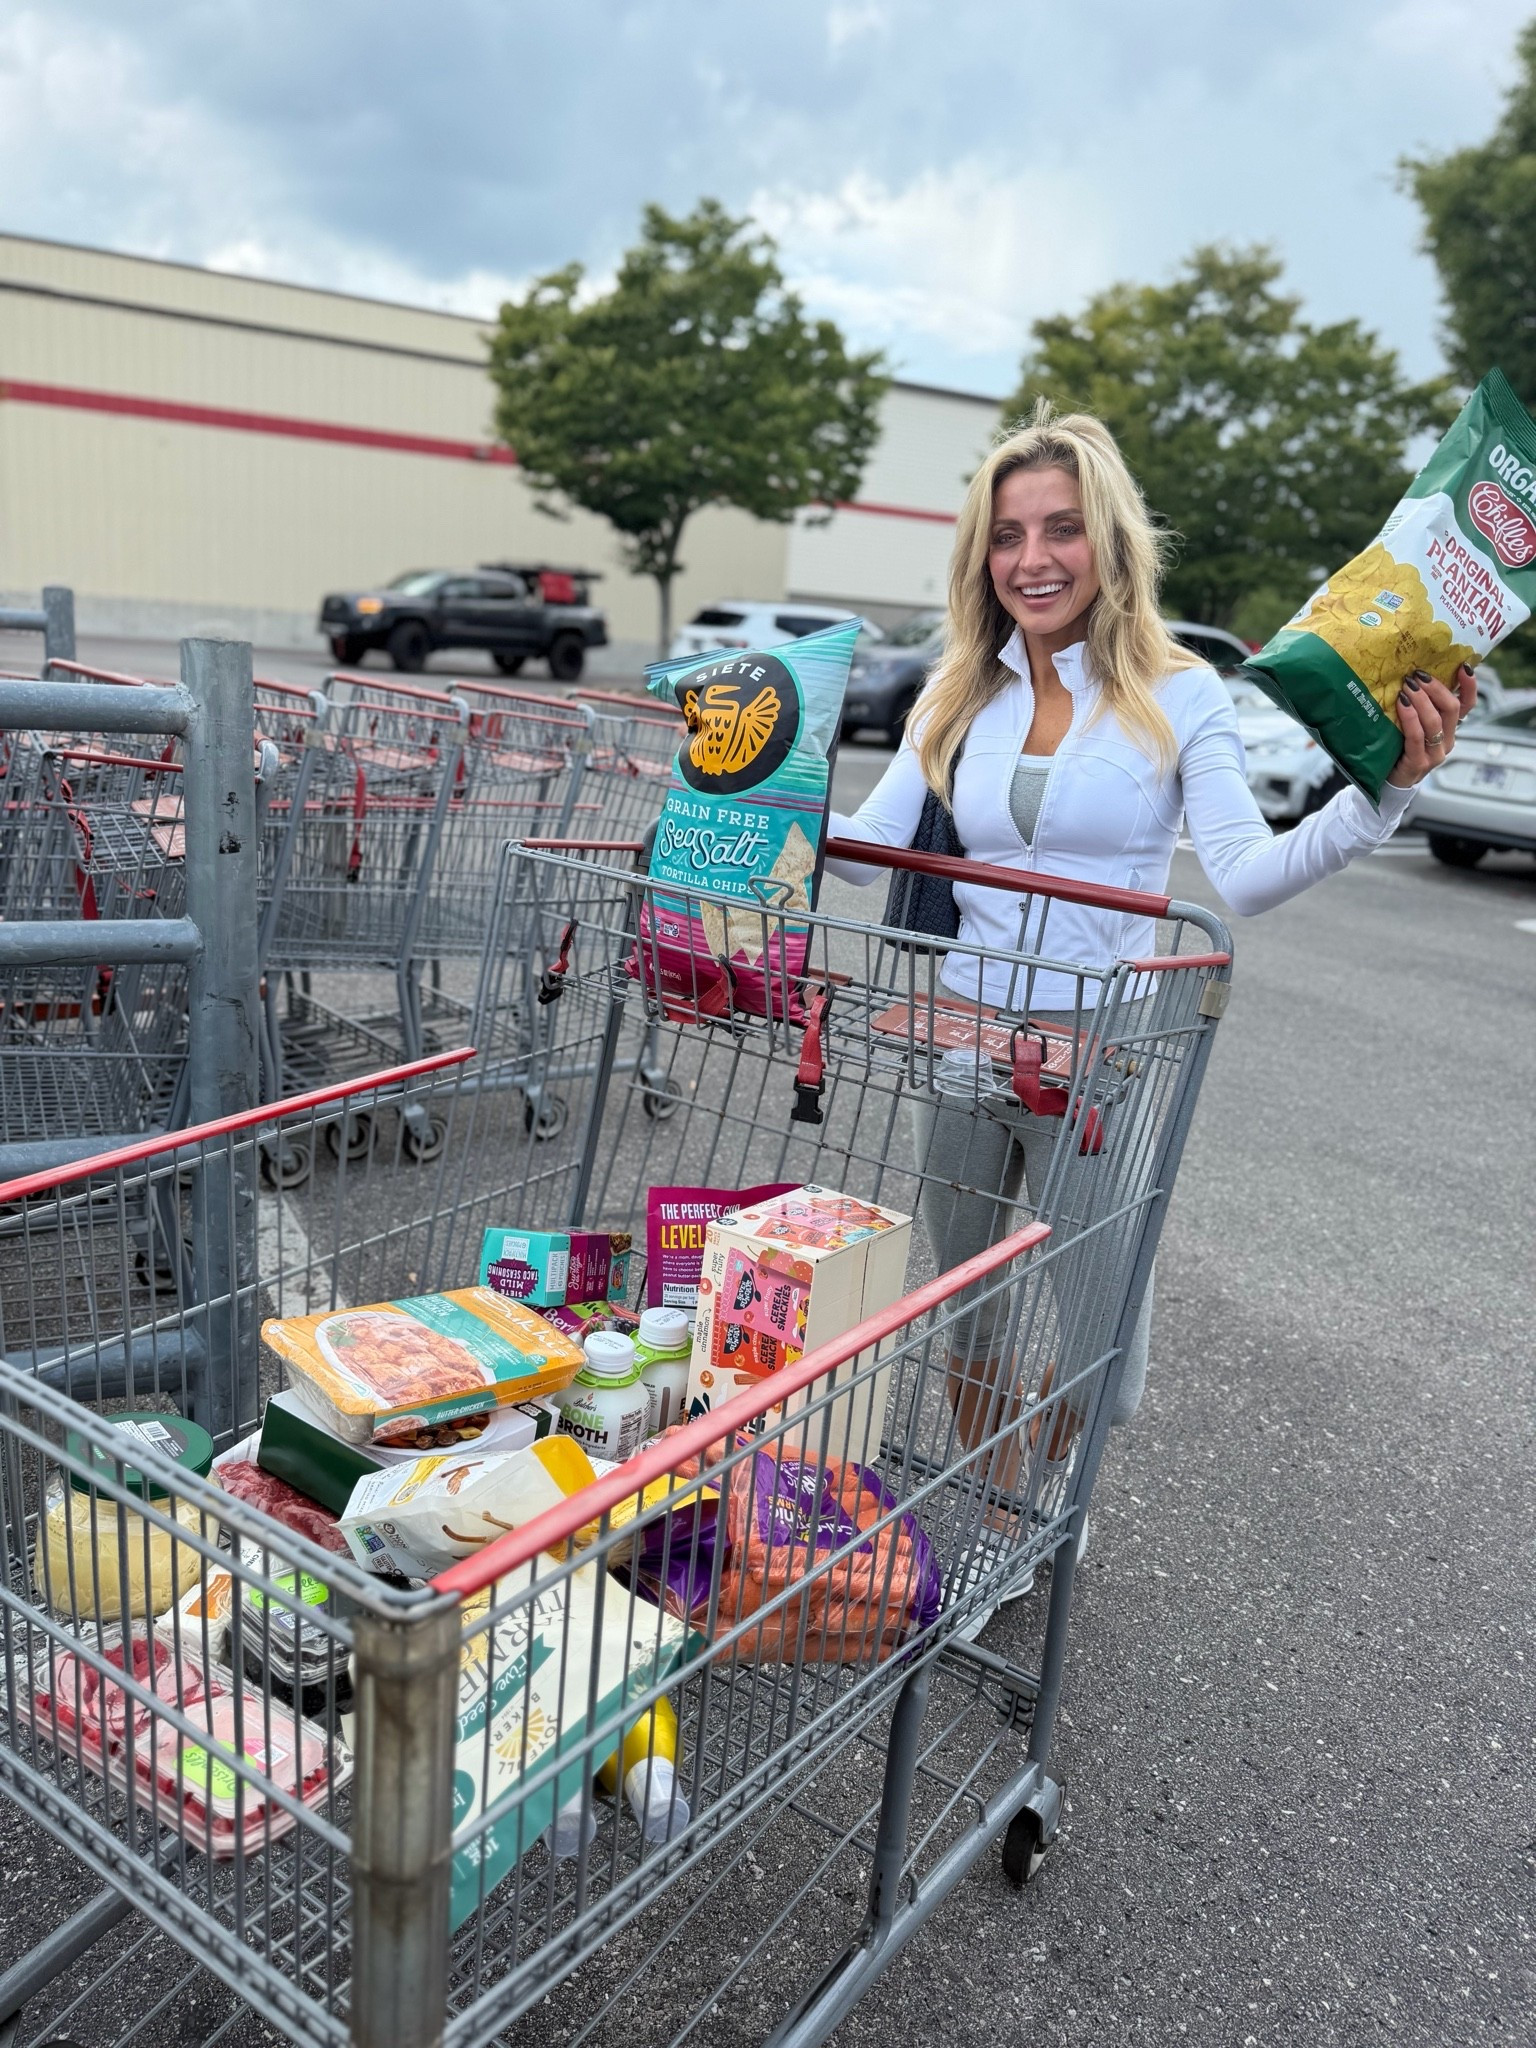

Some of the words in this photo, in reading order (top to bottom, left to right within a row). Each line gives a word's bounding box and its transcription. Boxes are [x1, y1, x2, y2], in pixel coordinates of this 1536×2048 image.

[1489, 444, 1536, 505] ORGA
[1472, 486, 1533, 563] Chifles
[1445, 536, 1504, 609] ORIGINAL
[1426, 538, 1507, 640] PLANTAIN
[1442, 579, 1478, 626] CHIPS
[1439, 594, 1468, 630] PLATANITOS
[696, 663, 767, 683] SIETE
[666, 797, 710, 820] GRAIN
[717, 809, 770, 830] FREE
[659, 818, 702, 858] Sea
[690, 830, 769, 870] Salt
[661, 865, 709, 888] TORTILLA
[660, 1203, 680, 1220] THE
[681, 1203, 722, 1220] PERFECT
[661, 1224, 705, 1249] LEVEL
[706, 1229, 714, 1244] 20
[487, 1264, 521, 1279] SEASONING
[522, 1269, 538, 1280] TACO
[550, 1253, 558, 1290] MULTIPACK
[558, 1255, 566, 1282] POUCHES
[717, 1253, 726, 1275] fruity
[499, 1278, 524, 1289] MILD
[500, 1288, 522, 1298] SIETE
[663, 1284, 695, 1293] Nutrition
[737, 1281, 746, 1300] SEVEN
[740, 1279, 753, 1309] SUNDAYS
[770, 1287, 784, 1324] CEREAL
[777, 1285, 792, 1331] SNACKIES
[701, 1316, 709, 1352] cinnamon
[761, 1333, 771, 1364] CERE
[768, 1336, 777, 1370] SNACK
[436, 1407, 460, 1420] BUTTER
[459, 1401, 485, 1414] CHICKEN
[562, 1403, 605, 1430] BONE
[573, 1398, 597, 1411] Butcher's
[557, 1416, 609, 1444] BROTH
[489, 1692, 541, 1747] BKER
[498, 1714, 558, 1775] JOYFLL
[185, 1751, 237, 1792] Driscll's
